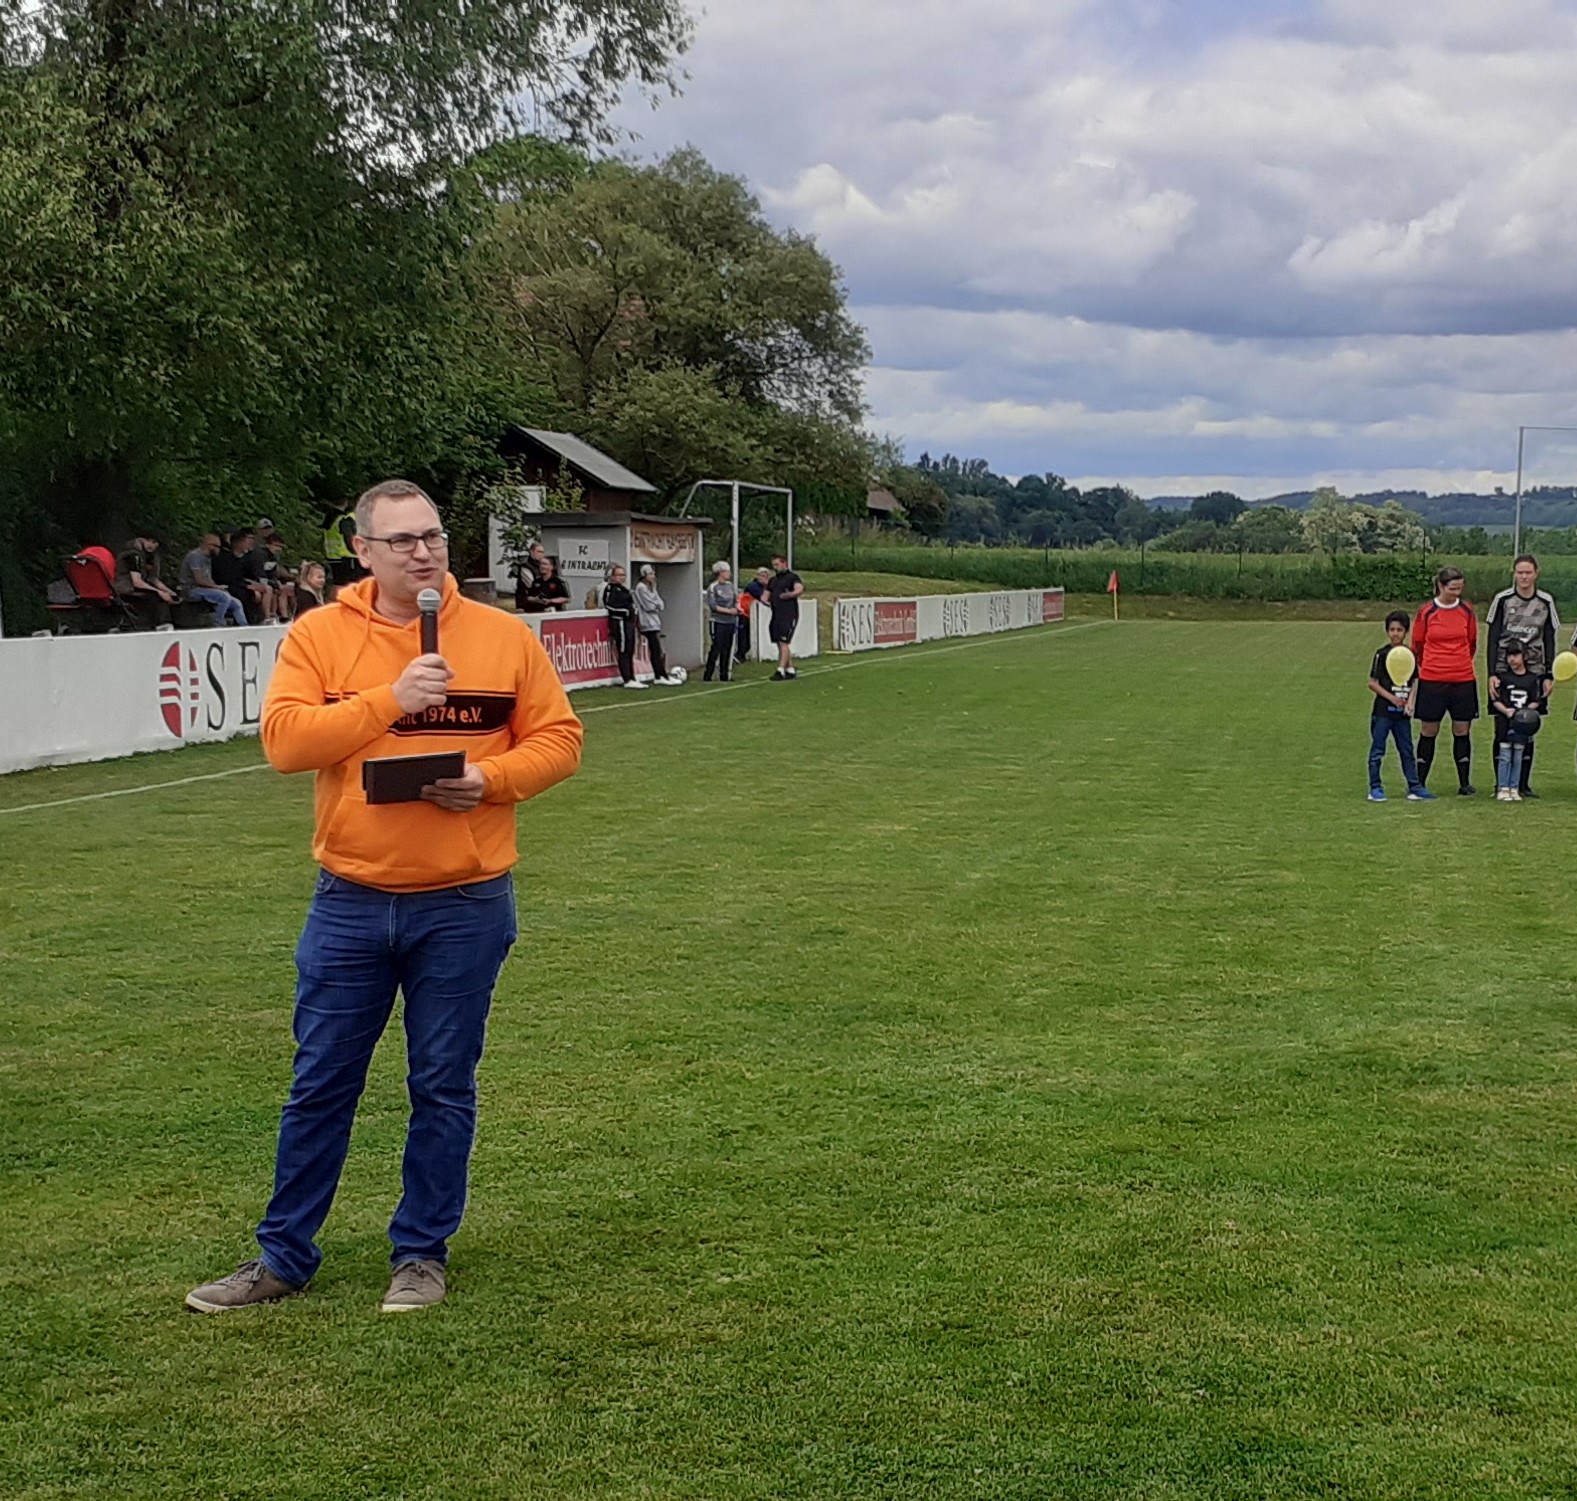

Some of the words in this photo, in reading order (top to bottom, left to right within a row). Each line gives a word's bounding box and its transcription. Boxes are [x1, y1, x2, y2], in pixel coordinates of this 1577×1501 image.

[851, 603, 873, 646] SES
[206, 639, 283, 732] SE
[423, 706, 456, 723] 1974
[460, 706, 482, 723] e.V.
